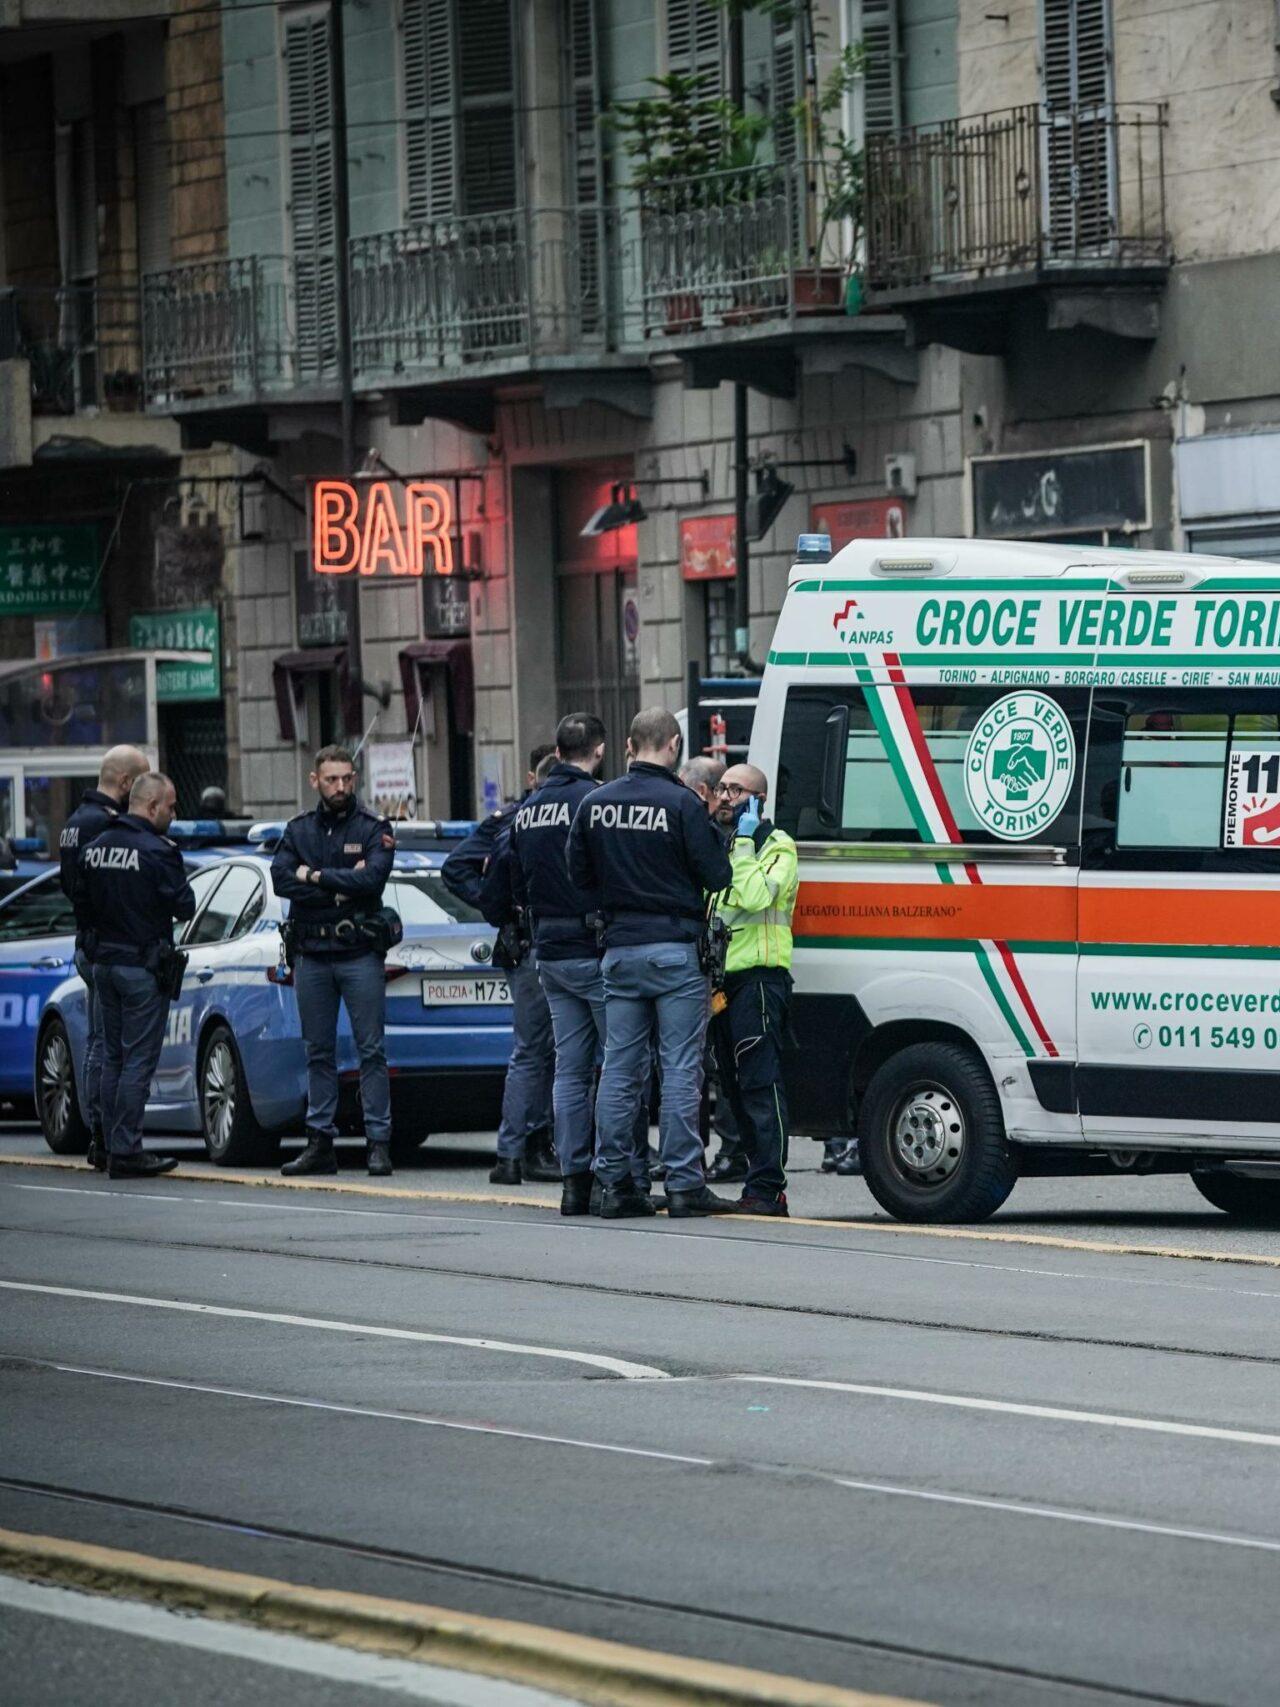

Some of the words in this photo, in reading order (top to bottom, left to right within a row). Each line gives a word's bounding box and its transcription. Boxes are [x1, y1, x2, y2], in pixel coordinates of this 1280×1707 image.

[314, 481, 453, 575] BAR
[916, 599, 1041, 646] CROCE
[1059, 600, 1177, 646] VERDE
[848, 631, 893, 644] ANPAS
[939, 669, 977, 683] TORINO
[991, 670, 1050, 684] ALPIGNANO
[1228, 672, 1250, 685] SAN
[970, 701, 1018, 773] CROCE
[1033, 701, 1069, 771] VERDE
[1013, 731, 1030, 741] 1907
[1226, 754, 1240, 845] PIEMONTE
[516, 802, 571, 832] POLIZIA
[590, 805, 669, 832] POLIZIA
[983, 800, 1051, 832] TORINO
[85, 847, 140, 871] POLIZIA
[428, 986, 468, 998] POLIZIA
[1159, 1026, 1201, 1047] 011
[1210, 1027, 1255, 1049] 549
